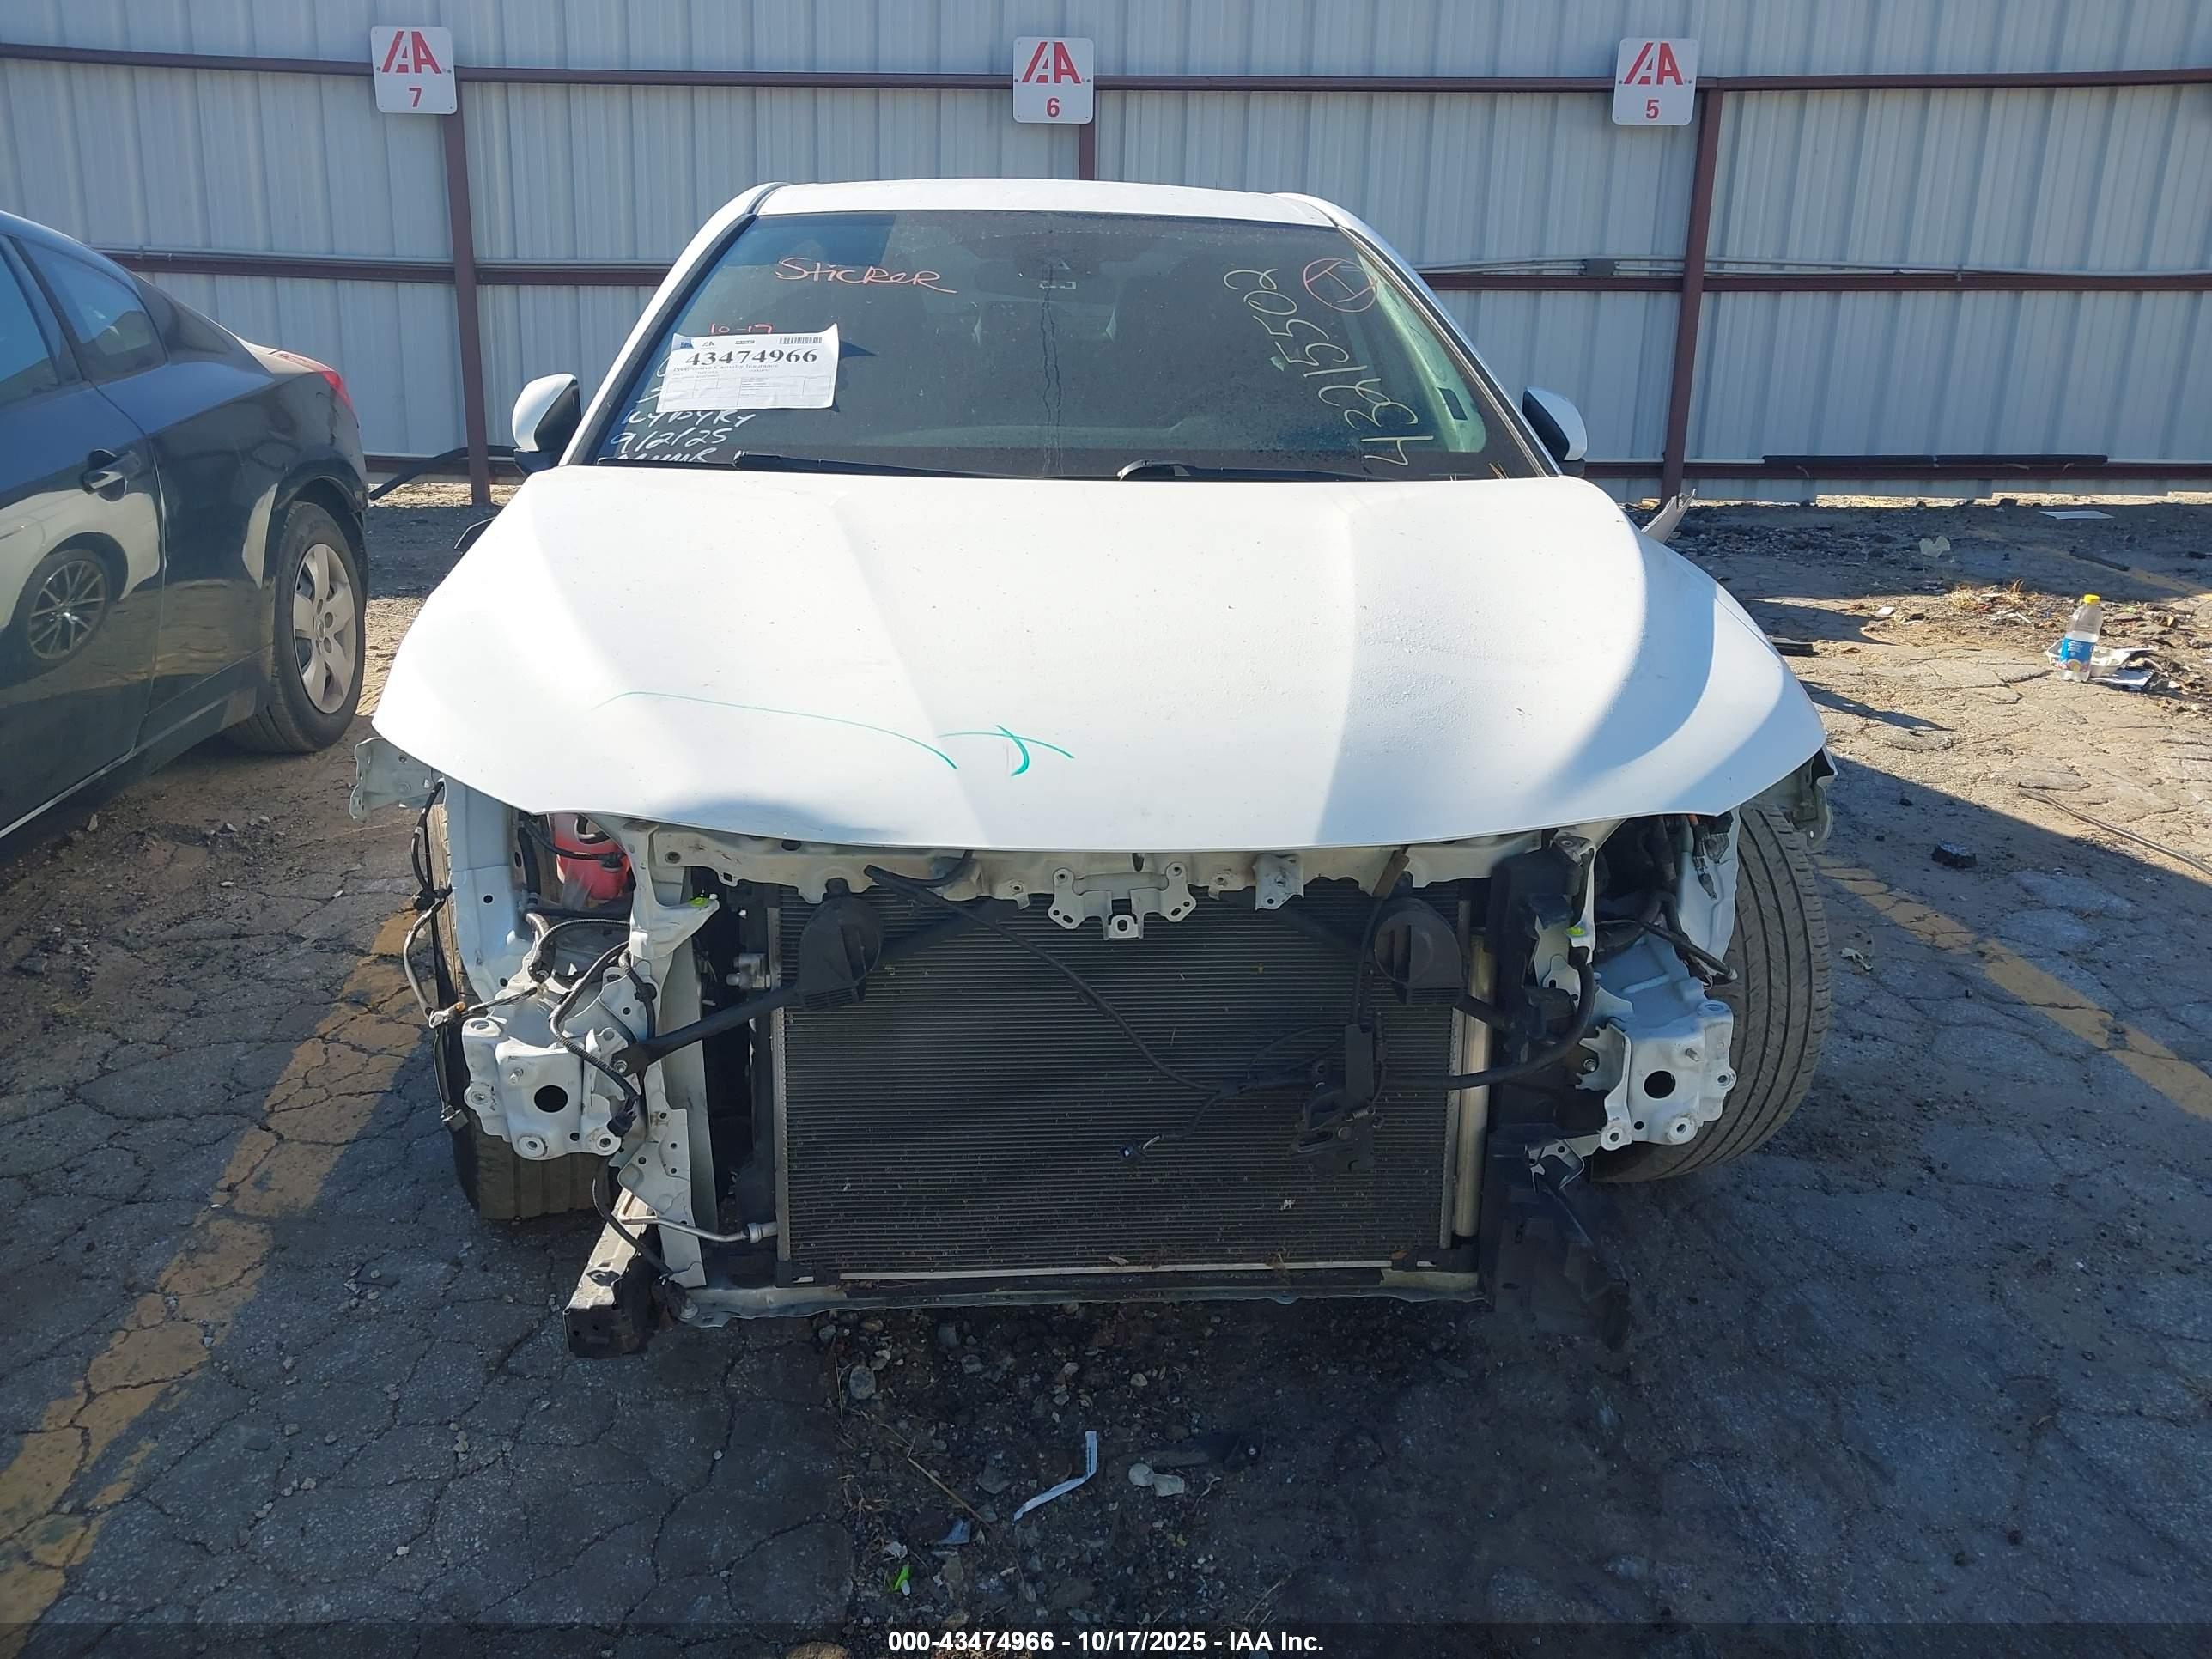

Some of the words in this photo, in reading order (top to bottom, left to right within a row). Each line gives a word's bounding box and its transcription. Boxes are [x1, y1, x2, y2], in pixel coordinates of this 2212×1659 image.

[409, 88, 422, 107] 7
[1046, 97, 1060, 118] 6
[1645, 99, 1660, 119] 5
[685, 349, 818, 366] 43474966
[611, 427, 732, 454] 9/2/25
